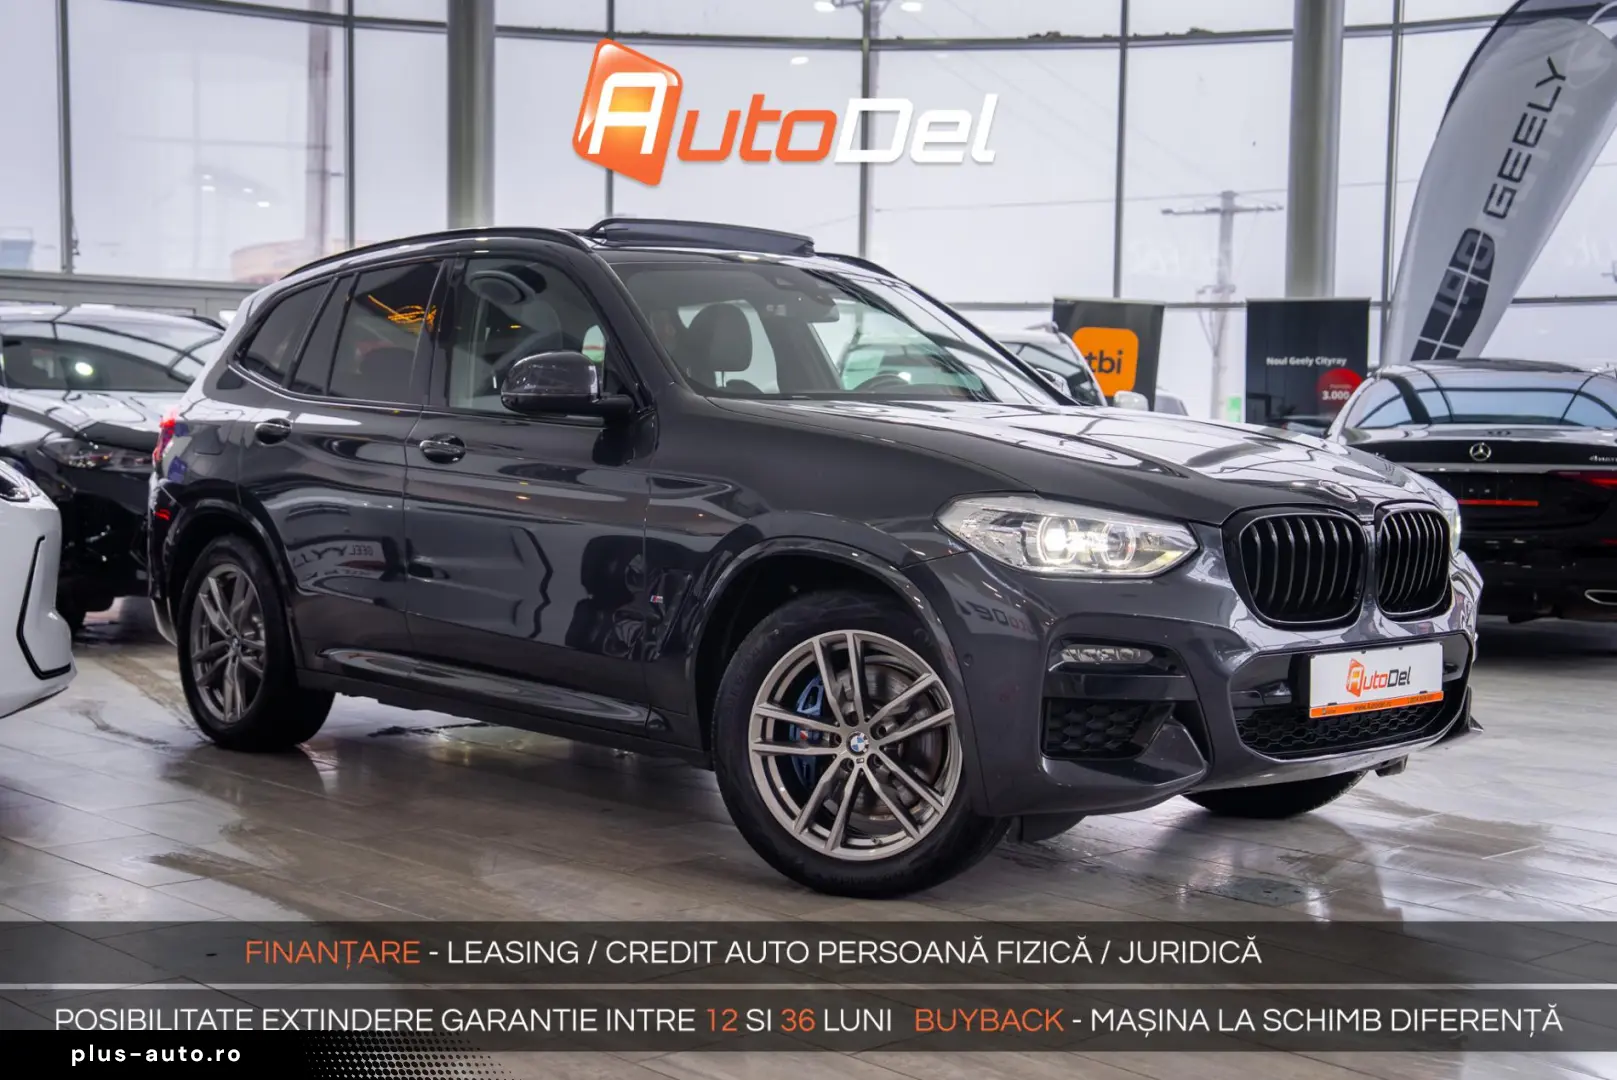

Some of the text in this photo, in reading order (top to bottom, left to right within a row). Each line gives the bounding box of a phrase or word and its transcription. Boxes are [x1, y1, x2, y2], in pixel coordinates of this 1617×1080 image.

[1483, 56, 1566, 219] GEELY
[1085, 350, 1123, 374] tbi
[1266, 356, 1347, 367] Noul Geely Cityray
[1322, 390, 1350, 401] 3.000
[1347, 664, 1411, 692] AutoDel
